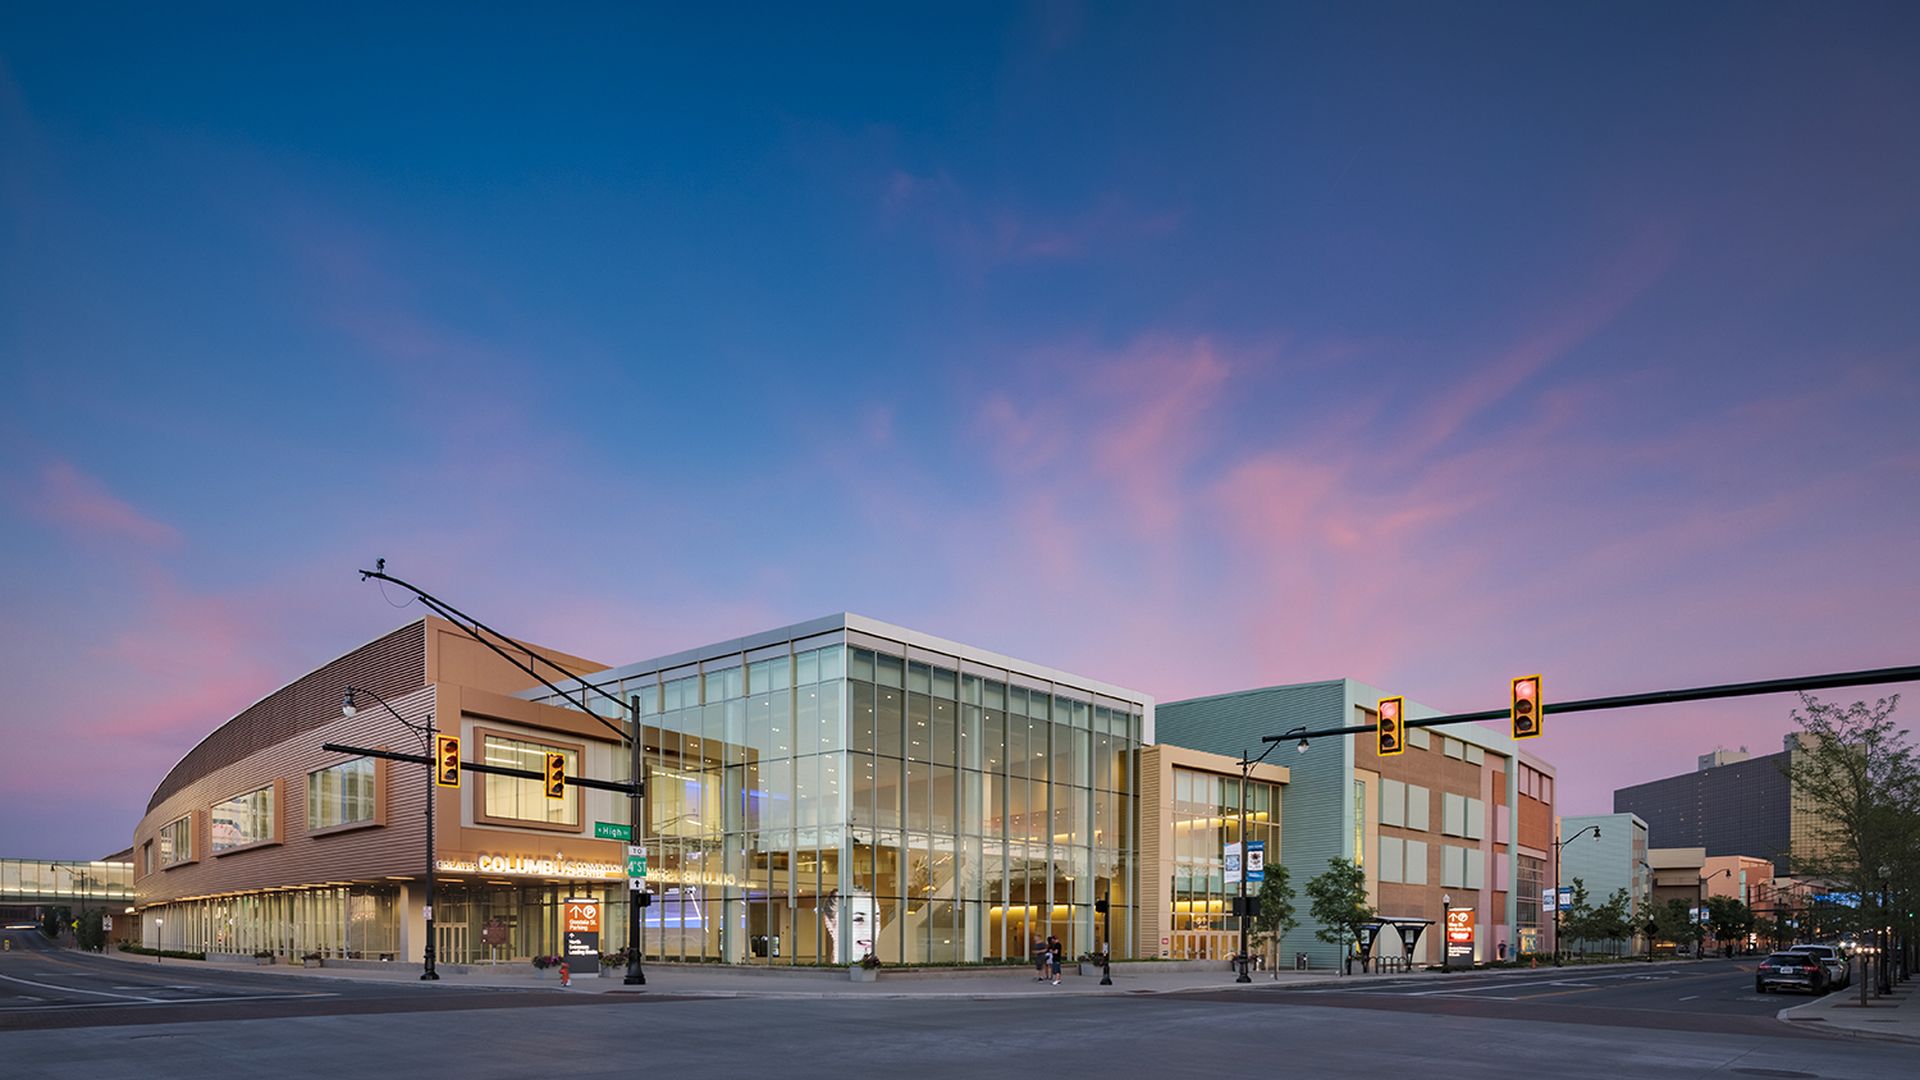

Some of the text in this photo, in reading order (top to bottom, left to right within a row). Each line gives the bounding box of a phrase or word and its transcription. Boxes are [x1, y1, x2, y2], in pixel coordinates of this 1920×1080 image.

[603, 827, 622, 838] High
[436, 855, 576, 876] GREATER COLUMBUS
[576, 862, 623, 873] CONVENTION
[637, 861, 646, 873] ST
